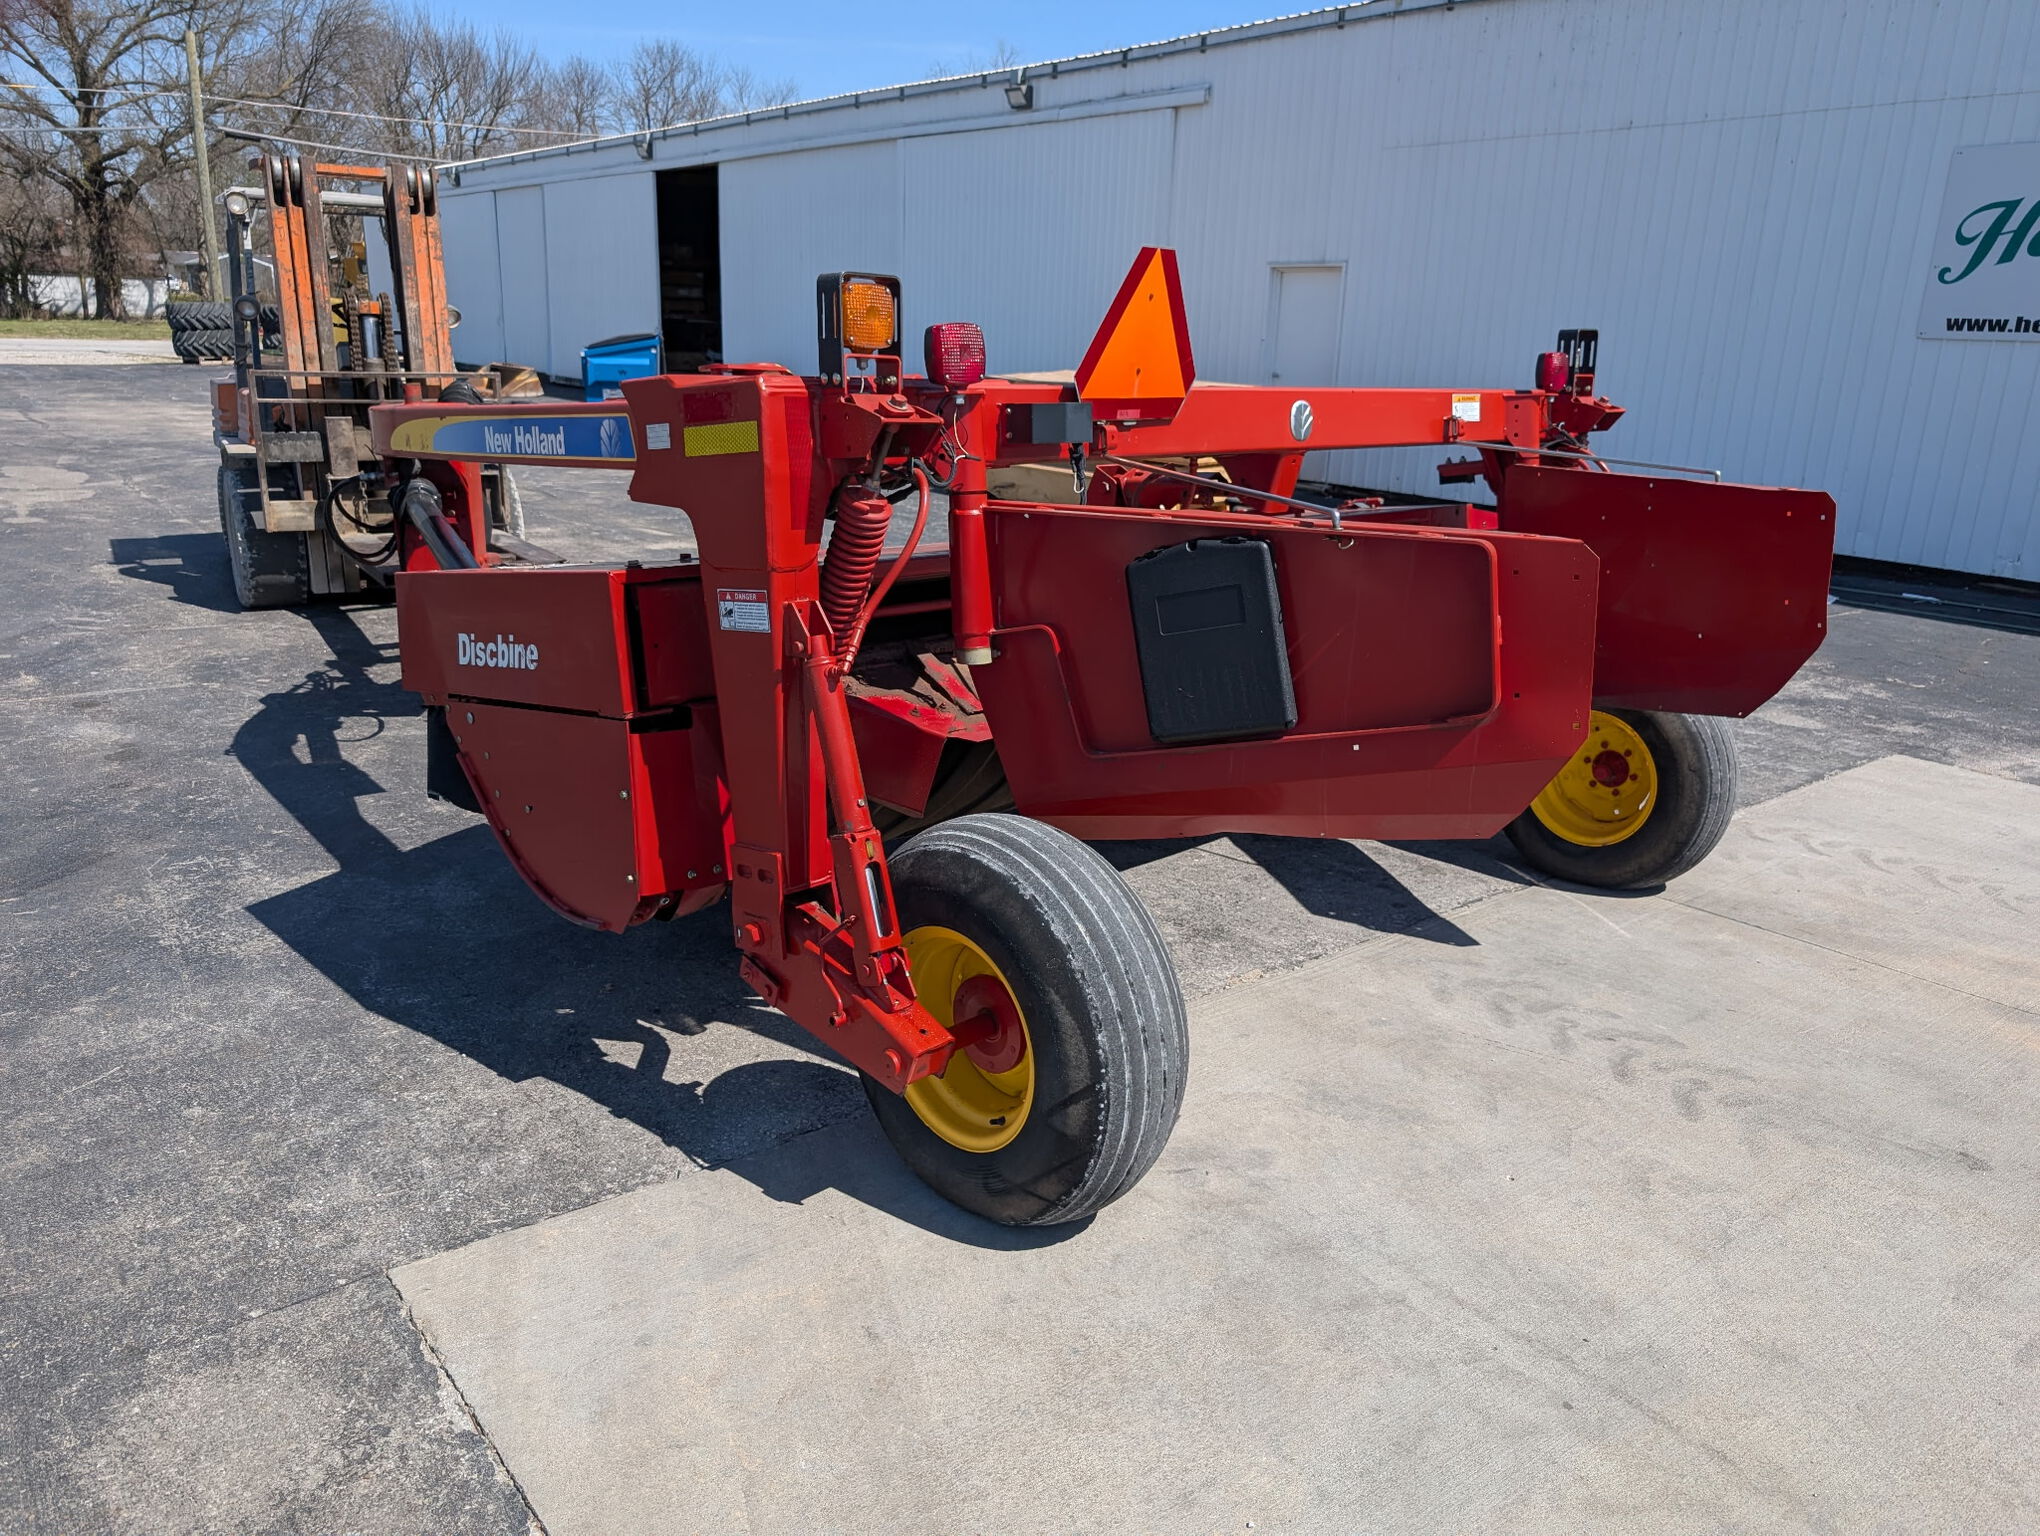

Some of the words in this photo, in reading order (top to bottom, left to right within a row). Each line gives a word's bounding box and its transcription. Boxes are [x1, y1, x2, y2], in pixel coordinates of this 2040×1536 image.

[484, 425, 512, 453] New
[514, 425, 566, 455] Holland
[734, 593, 757, 601] DANGER
[457, 632, 539, 670] Discbine
